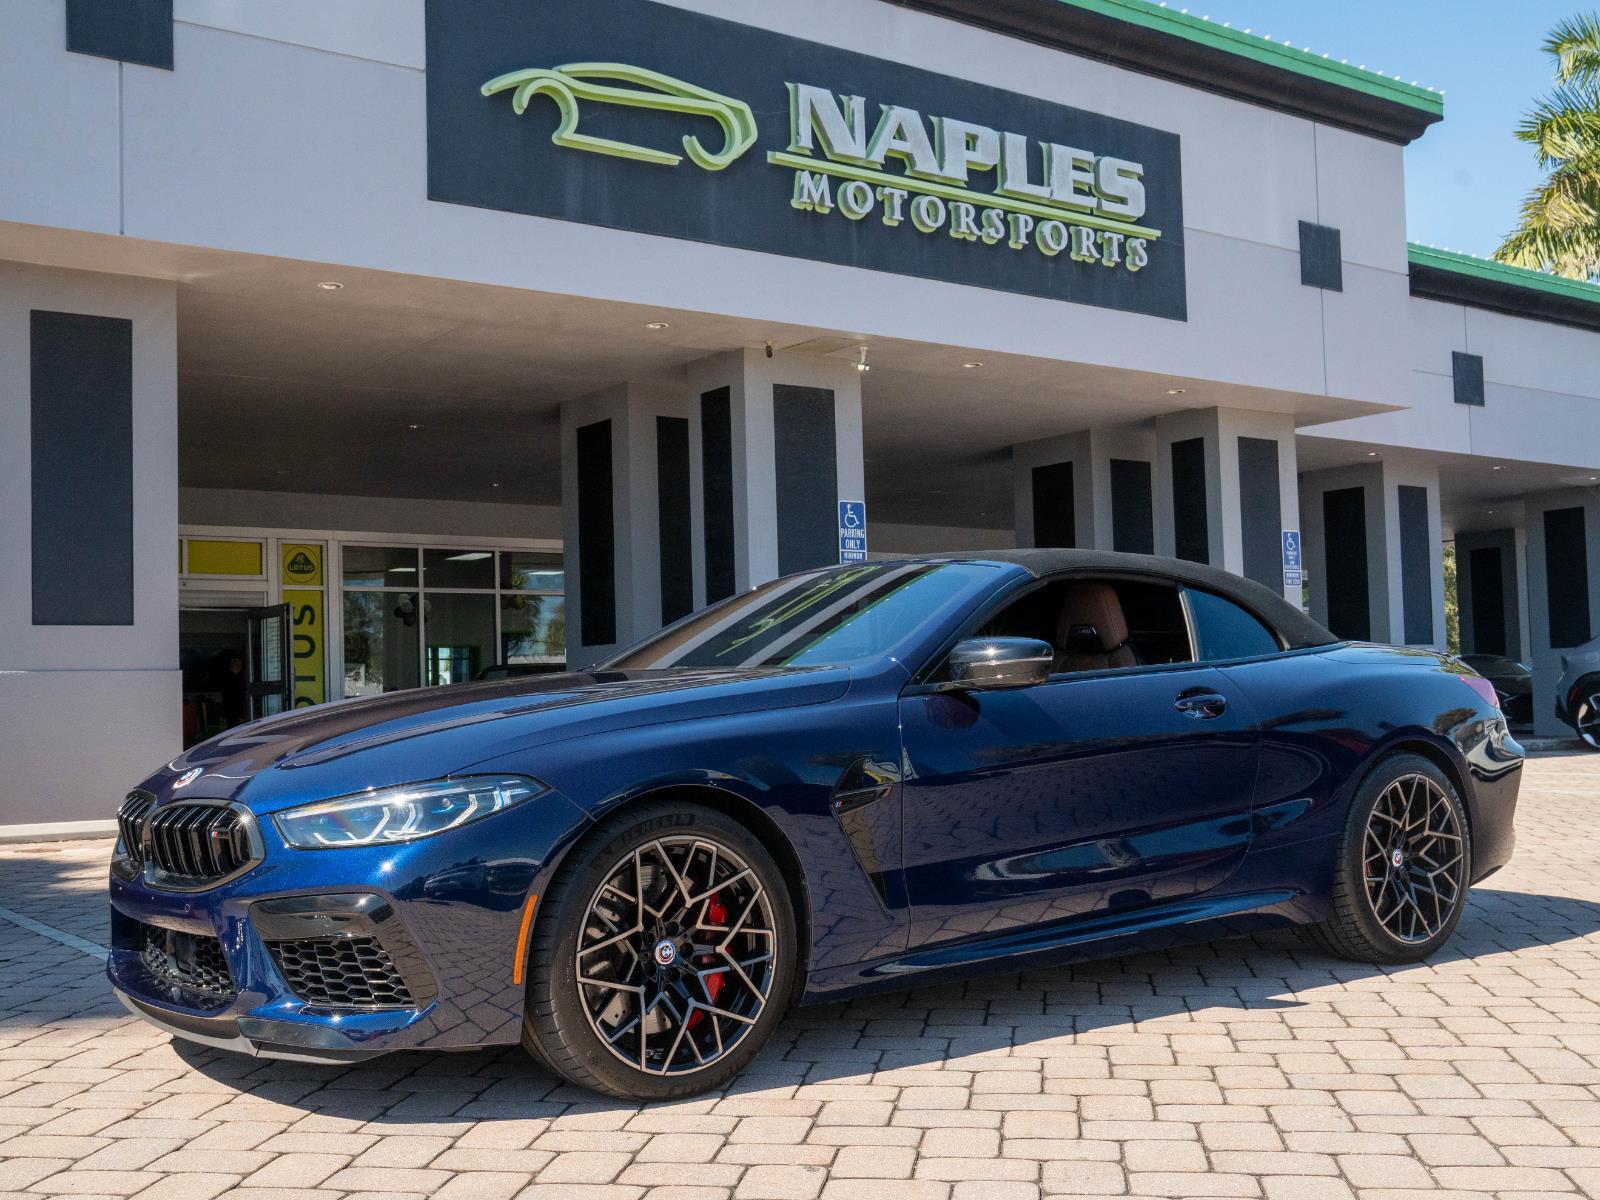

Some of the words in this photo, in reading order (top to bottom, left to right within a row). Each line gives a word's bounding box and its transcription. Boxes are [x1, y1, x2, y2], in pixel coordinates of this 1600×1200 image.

[785, 81, 1146, 221] NAPLES
[790, 169, 1149, 272] MOTORSPORTS
[840, 528, 865, 538] PARKING
[845, 539, 860, 549] ONLY
[289, 564, 314, 572] LOTUS
